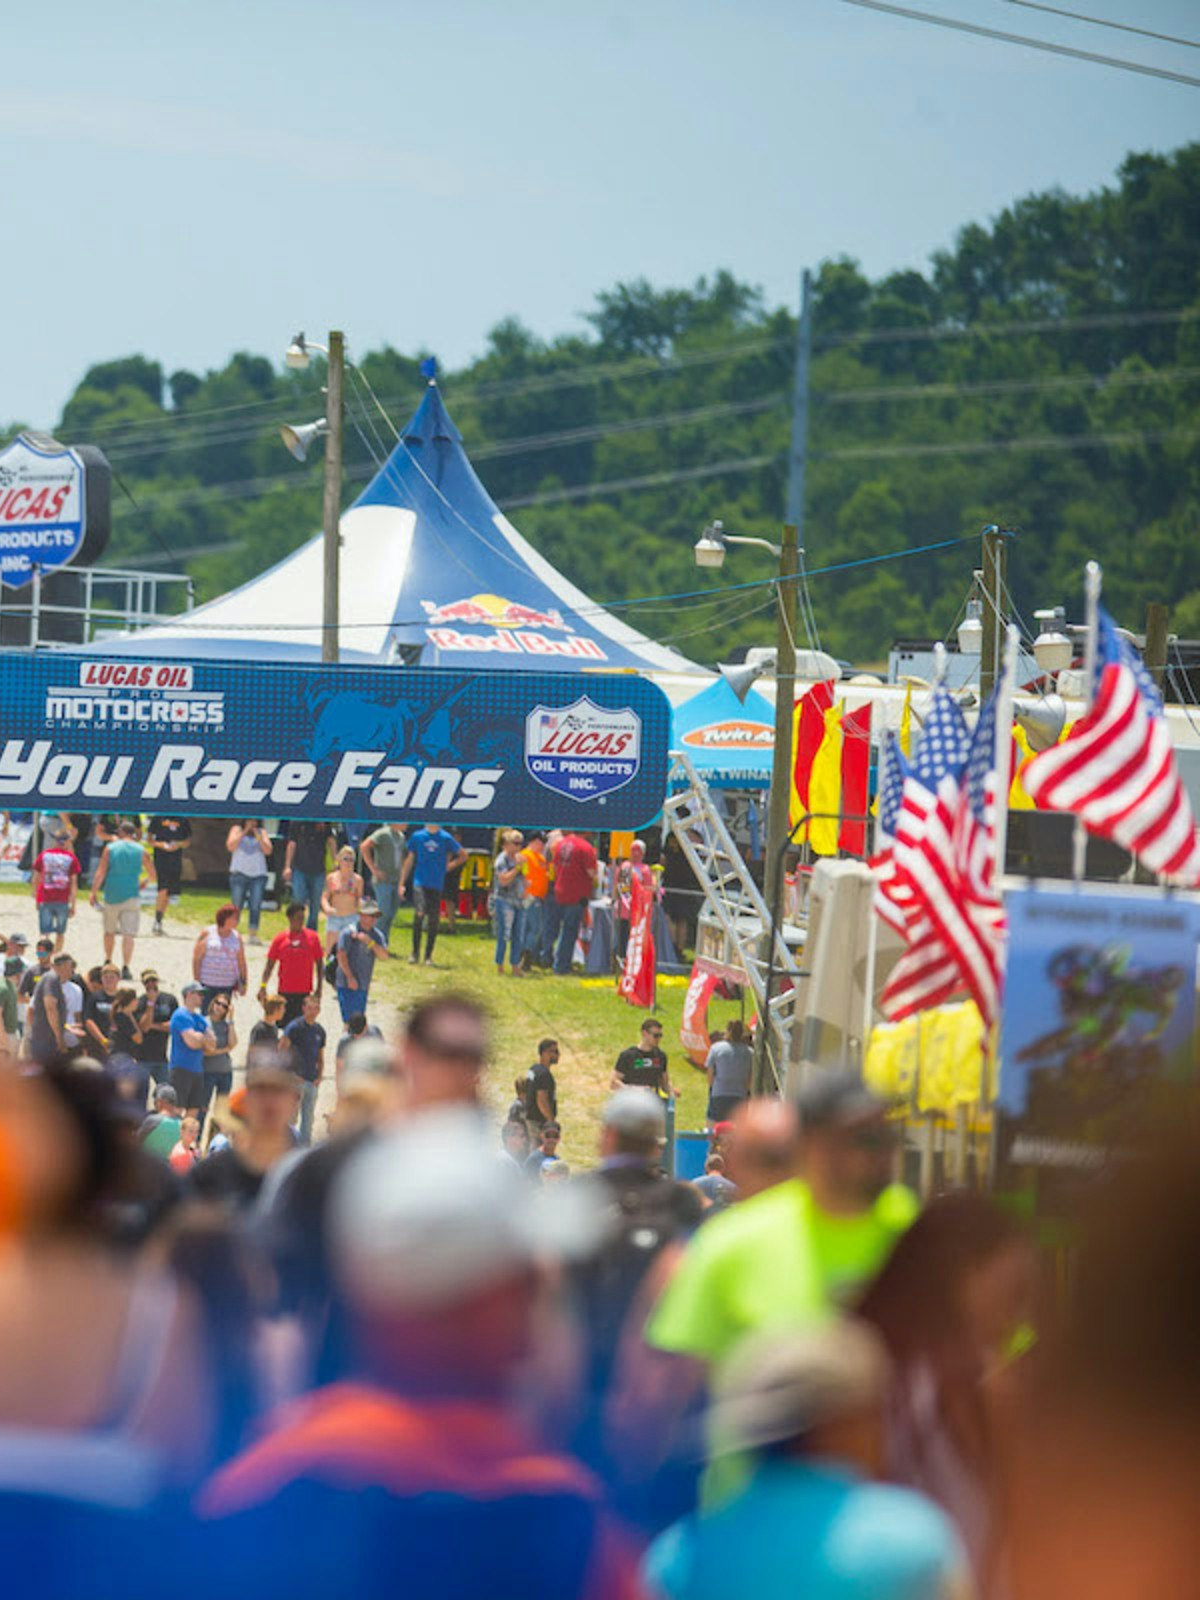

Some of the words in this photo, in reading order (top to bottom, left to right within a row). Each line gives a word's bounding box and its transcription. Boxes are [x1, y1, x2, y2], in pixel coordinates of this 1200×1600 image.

[424, 627, 524, 653] Red
[513, 631, 608, 661] Bull
[85, 664, 153, 687] LUCAS
[155, 667, 188, 688] OIL
[111, 690, 161, 700] PRO
[45, 697, 224, 724] MOTOCROSS
[45, 720, 224, 734] CHAMPIONSHIP
[540, 730, 633, 756] LUCAS
[140, 743, 317, 805] Race
[324, 751, 506, 811] Fans
[532, 760, 556, 773] OIL
[559, 761, 633, 776] PRODUCTS
[569, 778, 597, 790] INC.
